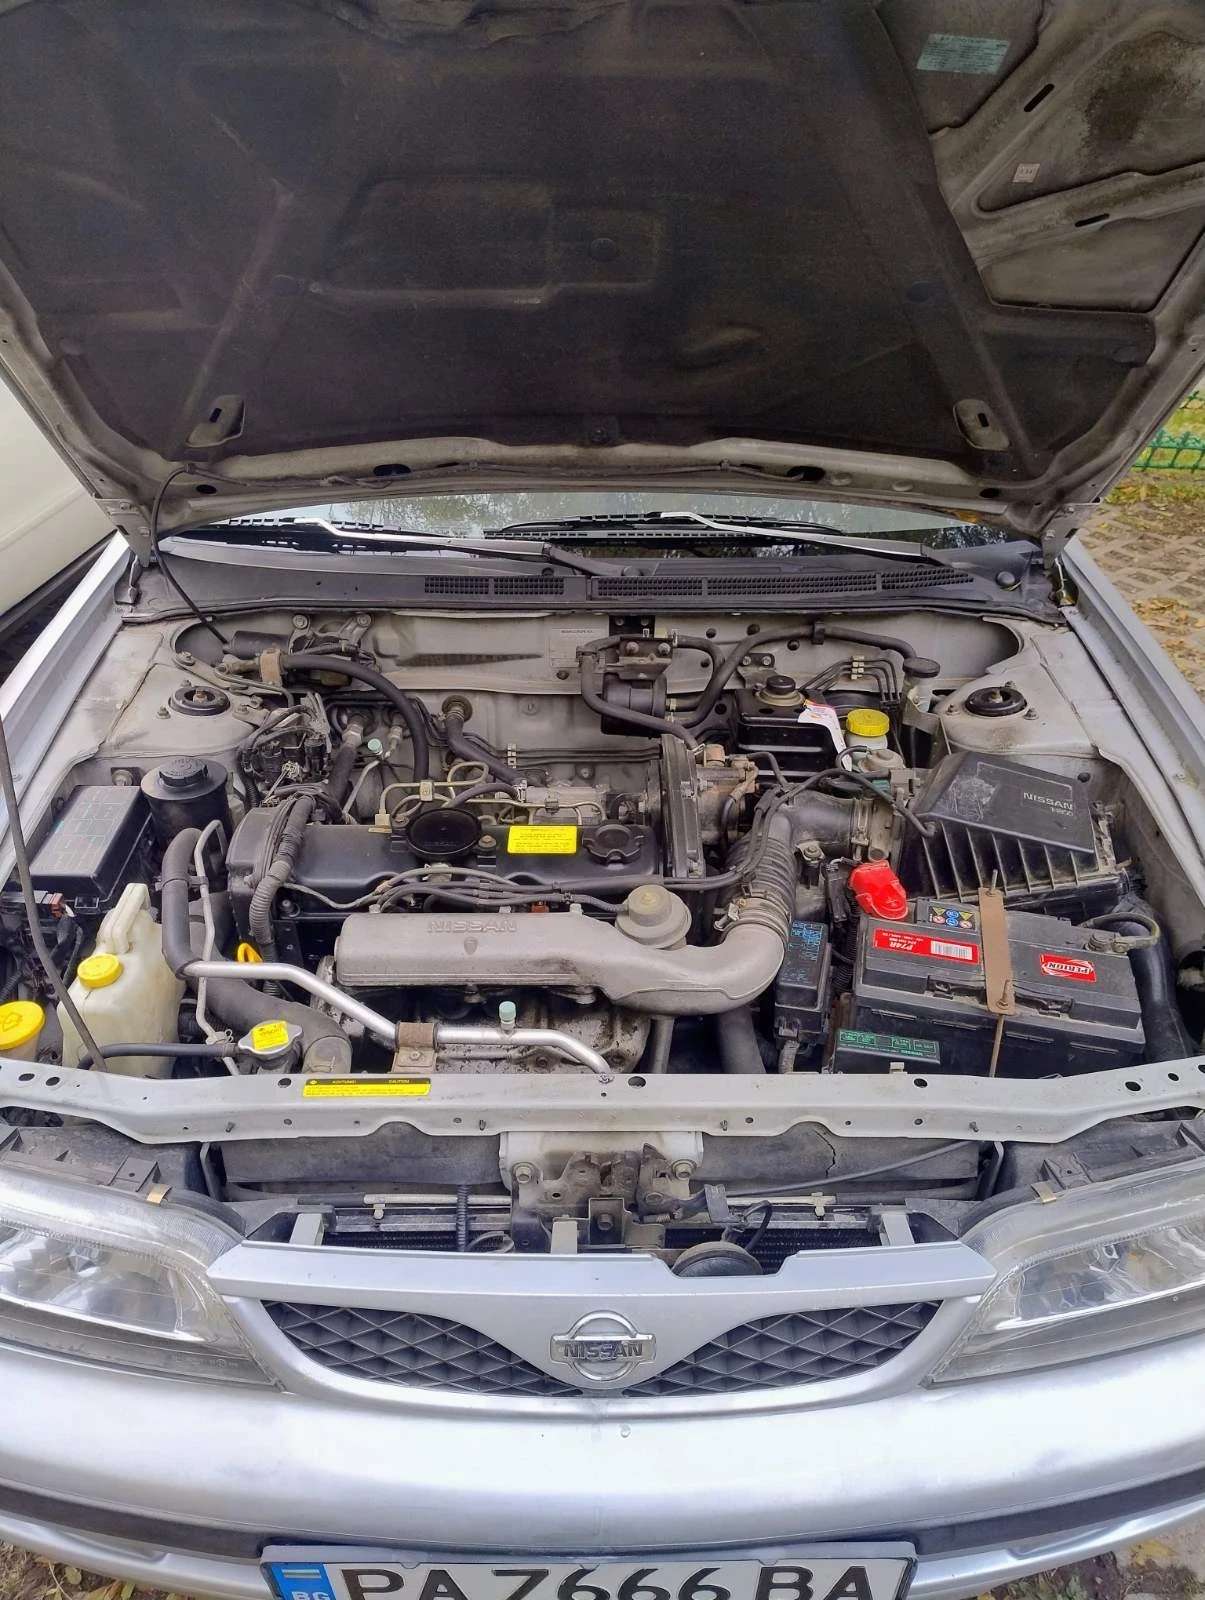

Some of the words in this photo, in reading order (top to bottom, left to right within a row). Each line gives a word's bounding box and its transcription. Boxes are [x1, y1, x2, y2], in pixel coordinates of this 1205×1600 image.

[1023, 792, 1073, 810] NISSAN
[427, 920, 517, 933] NISSAN
[1048, 962, 1090, 974] PERION
[563, 1343, 643, 1359] NISSAN
[341, 1568, 471, 1600] PA
[491, 1566, 732, 1600] 7666
[754, 1565, 875, 1600] BA
